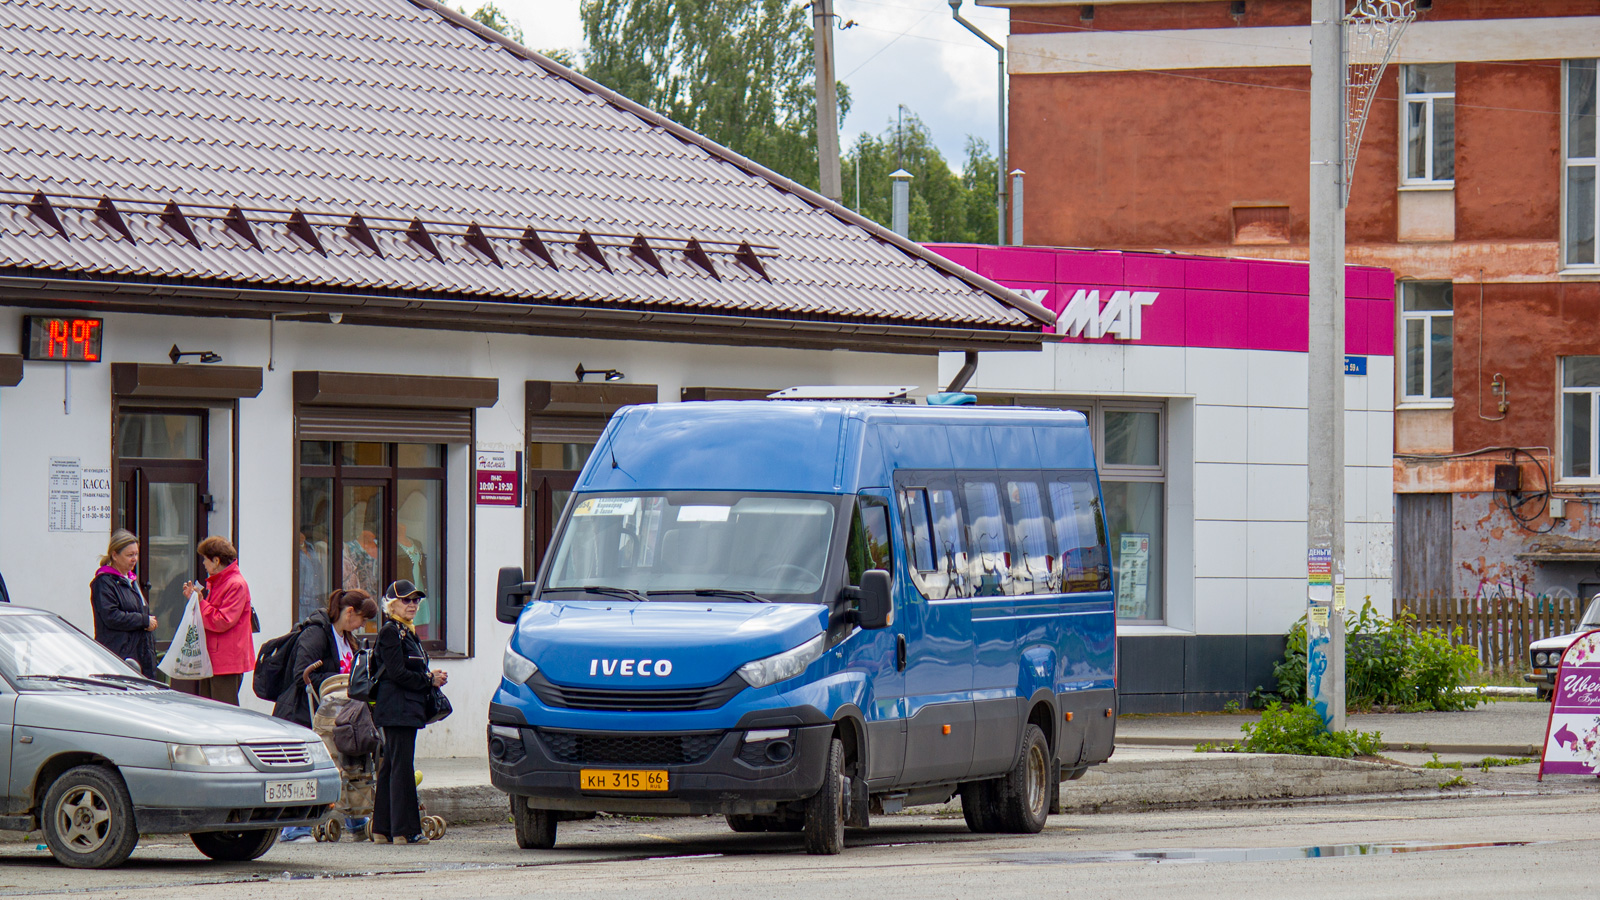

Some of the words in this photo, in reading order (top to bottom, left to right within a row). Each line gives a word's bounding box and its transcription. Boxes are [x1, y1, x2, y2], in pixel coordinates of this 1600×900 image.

[82, 479, 110, 490] КАССА
[479, 482, 495, 491] 10:00
[498, 483, 513, 491] 19:30
[1308, 549, 1332, 557] ДЕНЬГИ
[589, 659, 673, 677] IVECO
[612, 773, 640, 788] 315
[647, 772, 663, 784] 66
